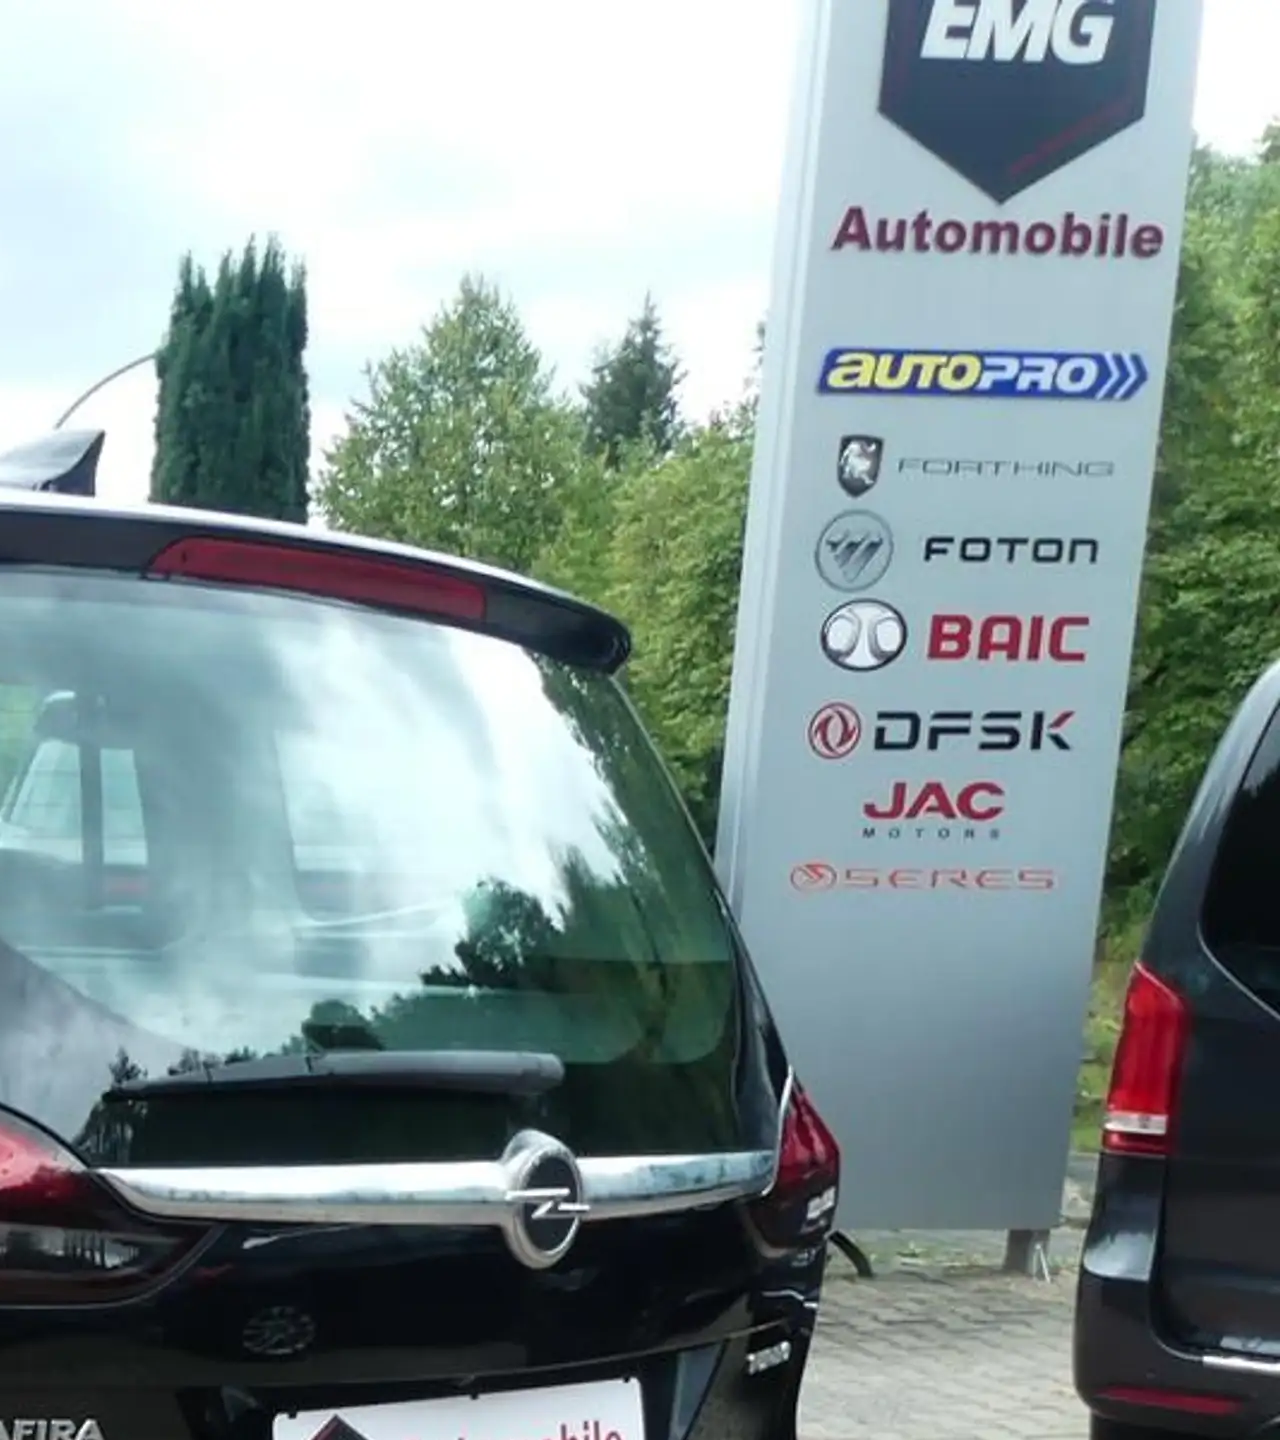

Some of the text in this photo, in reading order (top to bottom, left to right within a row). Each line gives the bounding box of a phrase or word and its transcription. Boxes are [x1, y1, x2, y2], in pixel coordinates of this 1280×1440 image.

[920, 0, 1116, 66] EMG
[830, 205, 1164, 259] Automobile
[897, 457, 1116, 478] FORTHING
[923, 536, 1099, 564] FOTON
[926, 613, 1090, 663] BAIC
[873, 710, 1077, 752] DFSK
[862, 781, 1006, 822] JAC
[862, 827, 1001, 840] MOTORS
[844, 868, 1055, 891] SERES
